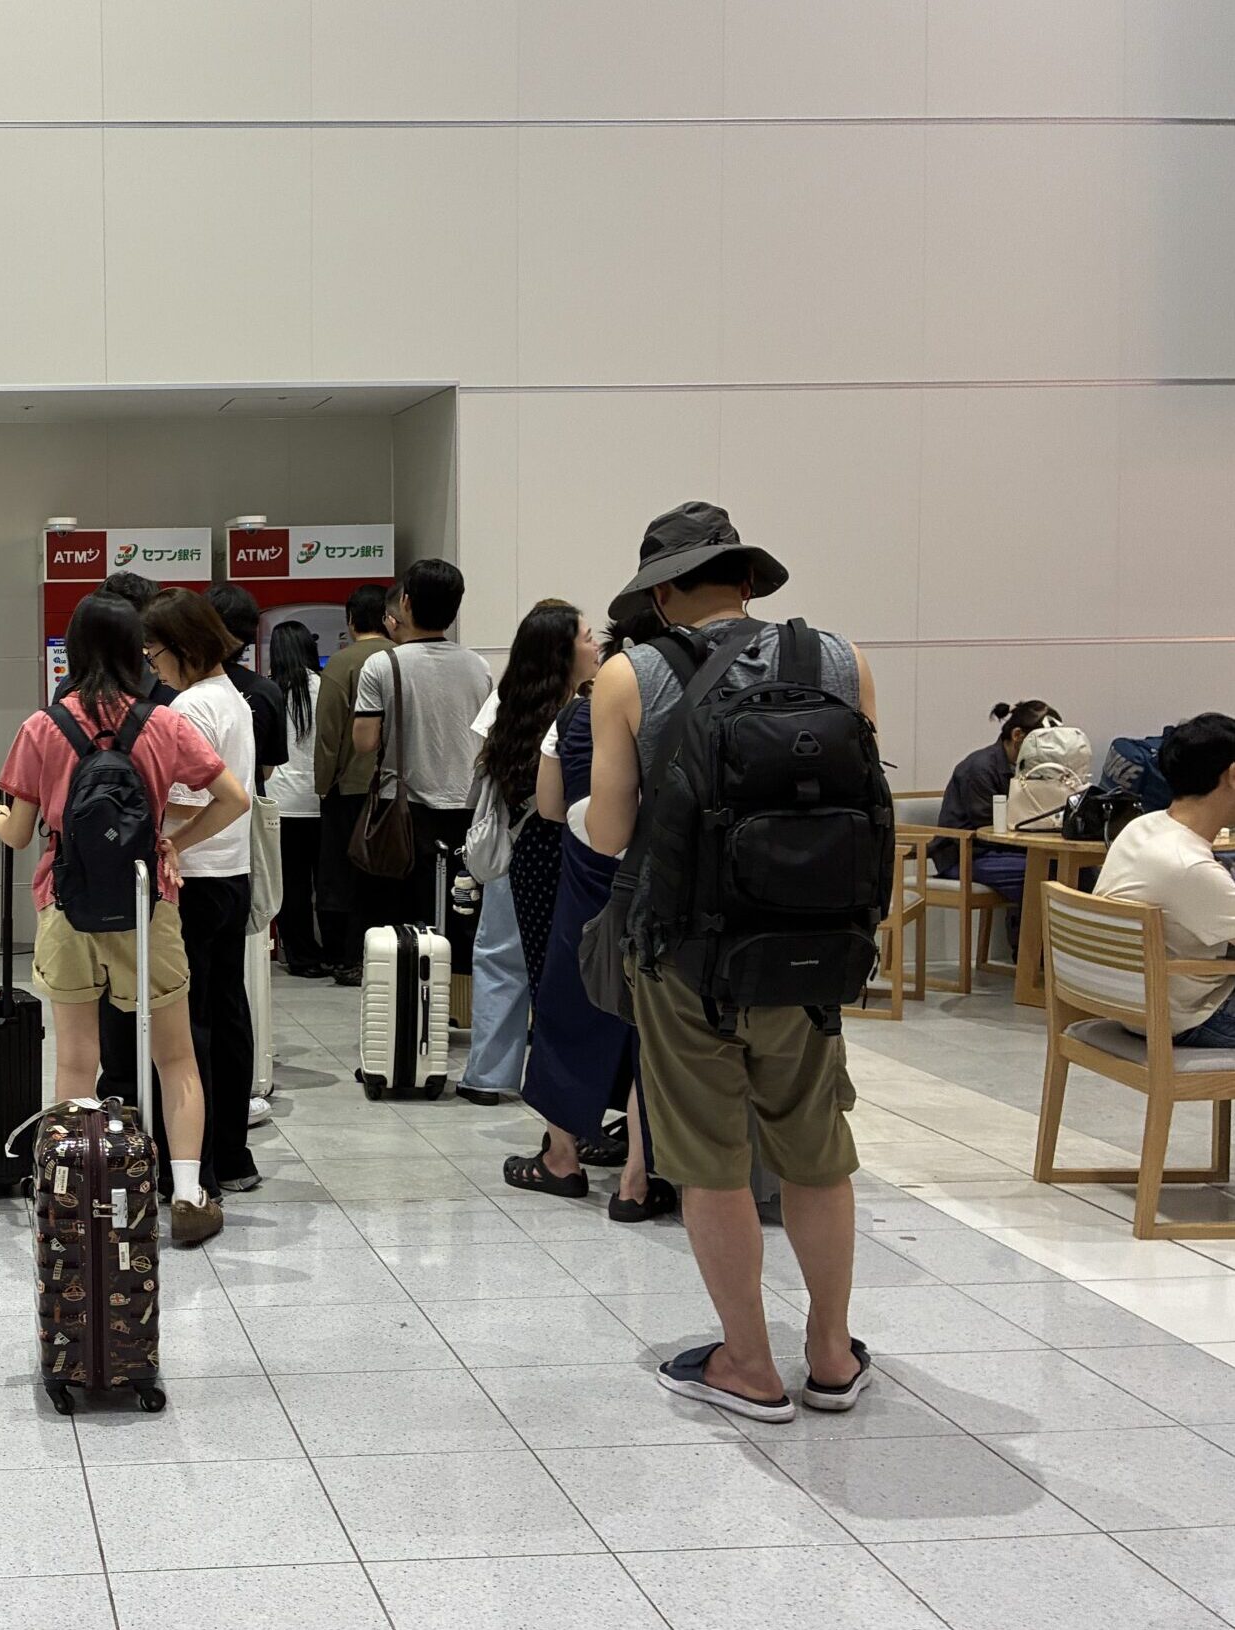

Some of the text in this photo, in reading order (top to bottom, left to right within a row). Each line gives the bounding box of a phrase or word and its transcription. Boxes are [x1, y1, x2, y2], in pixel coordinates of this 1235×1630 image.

[53, 551, 87, 563] ATM
[142, 548, 201, 561] セブン銀行
[236, 549, 270, 561] ATM
[325, 545, 384, 558] セブン銀行
